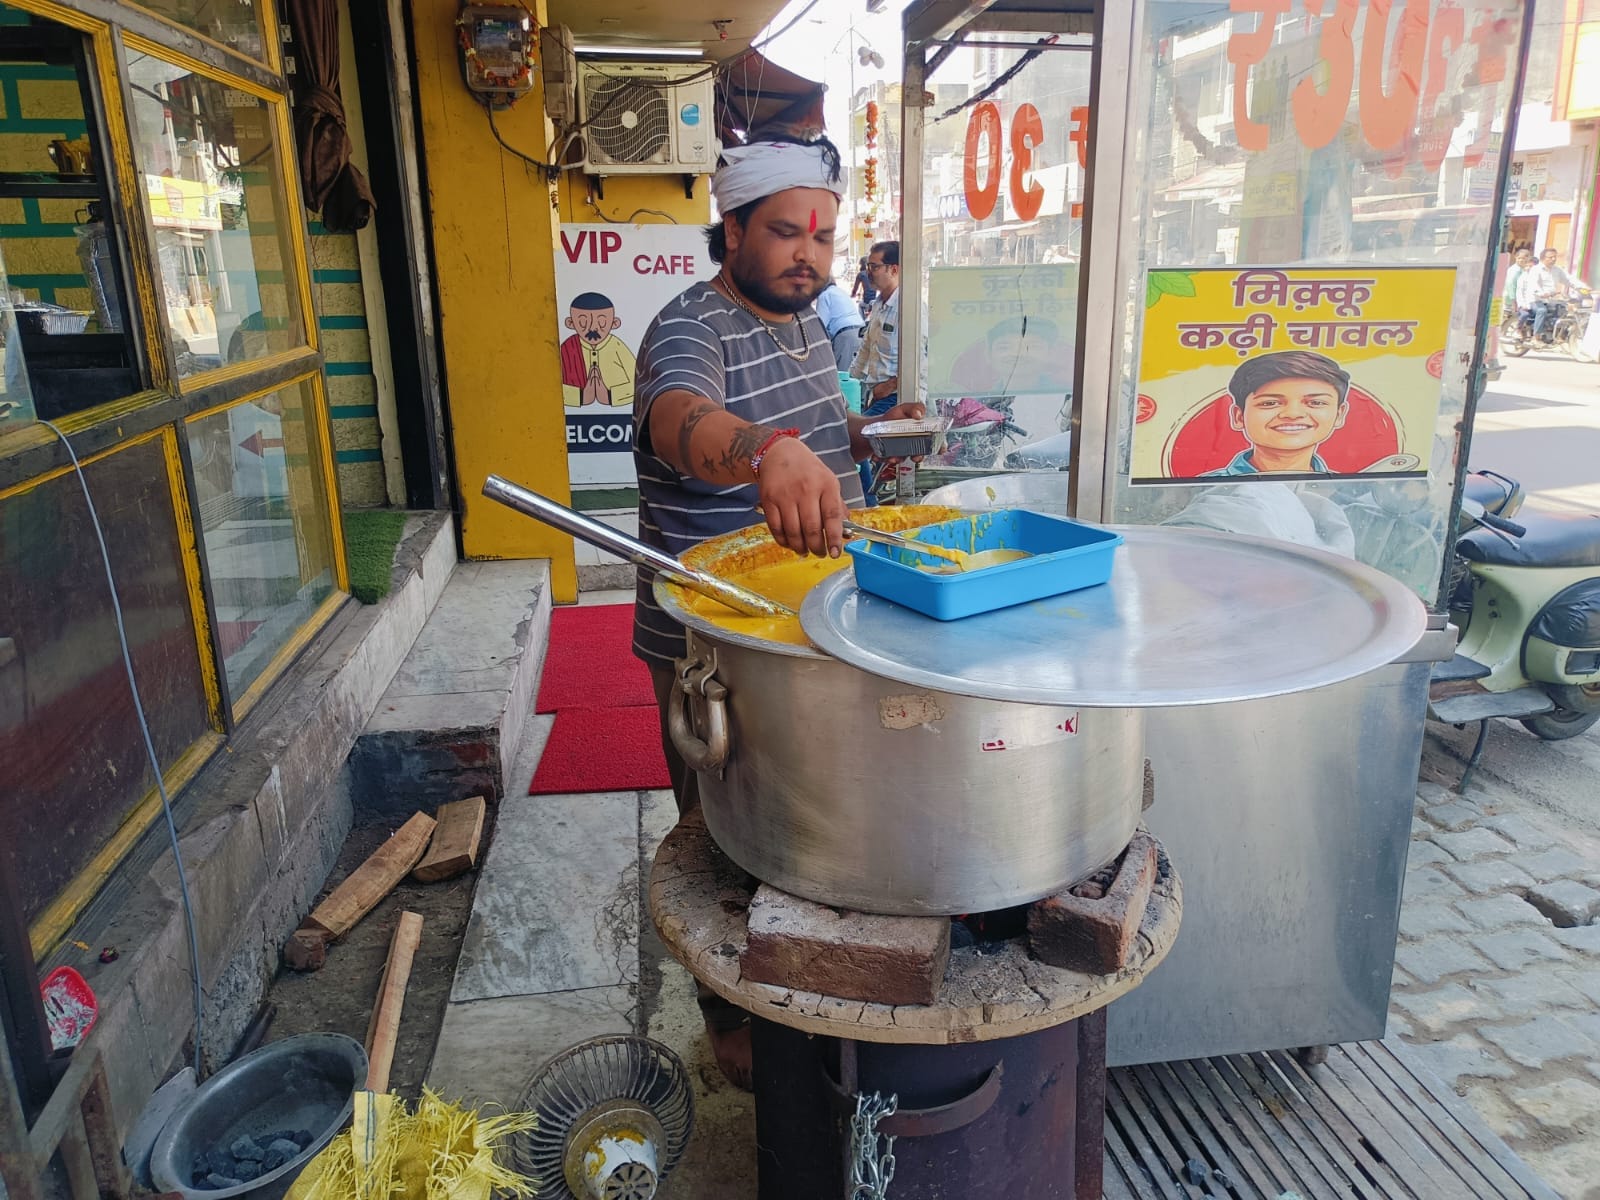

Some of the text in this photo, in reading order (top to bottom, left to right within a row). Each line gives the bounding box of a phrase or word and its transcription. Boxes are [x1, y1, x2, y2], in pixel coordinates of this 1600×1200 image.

[560, 231, 695, 275] VIP CAFE
[1178, 313, 1418, 357] कढ़ी चावल
[565, 424, 632, 443] ELCO
